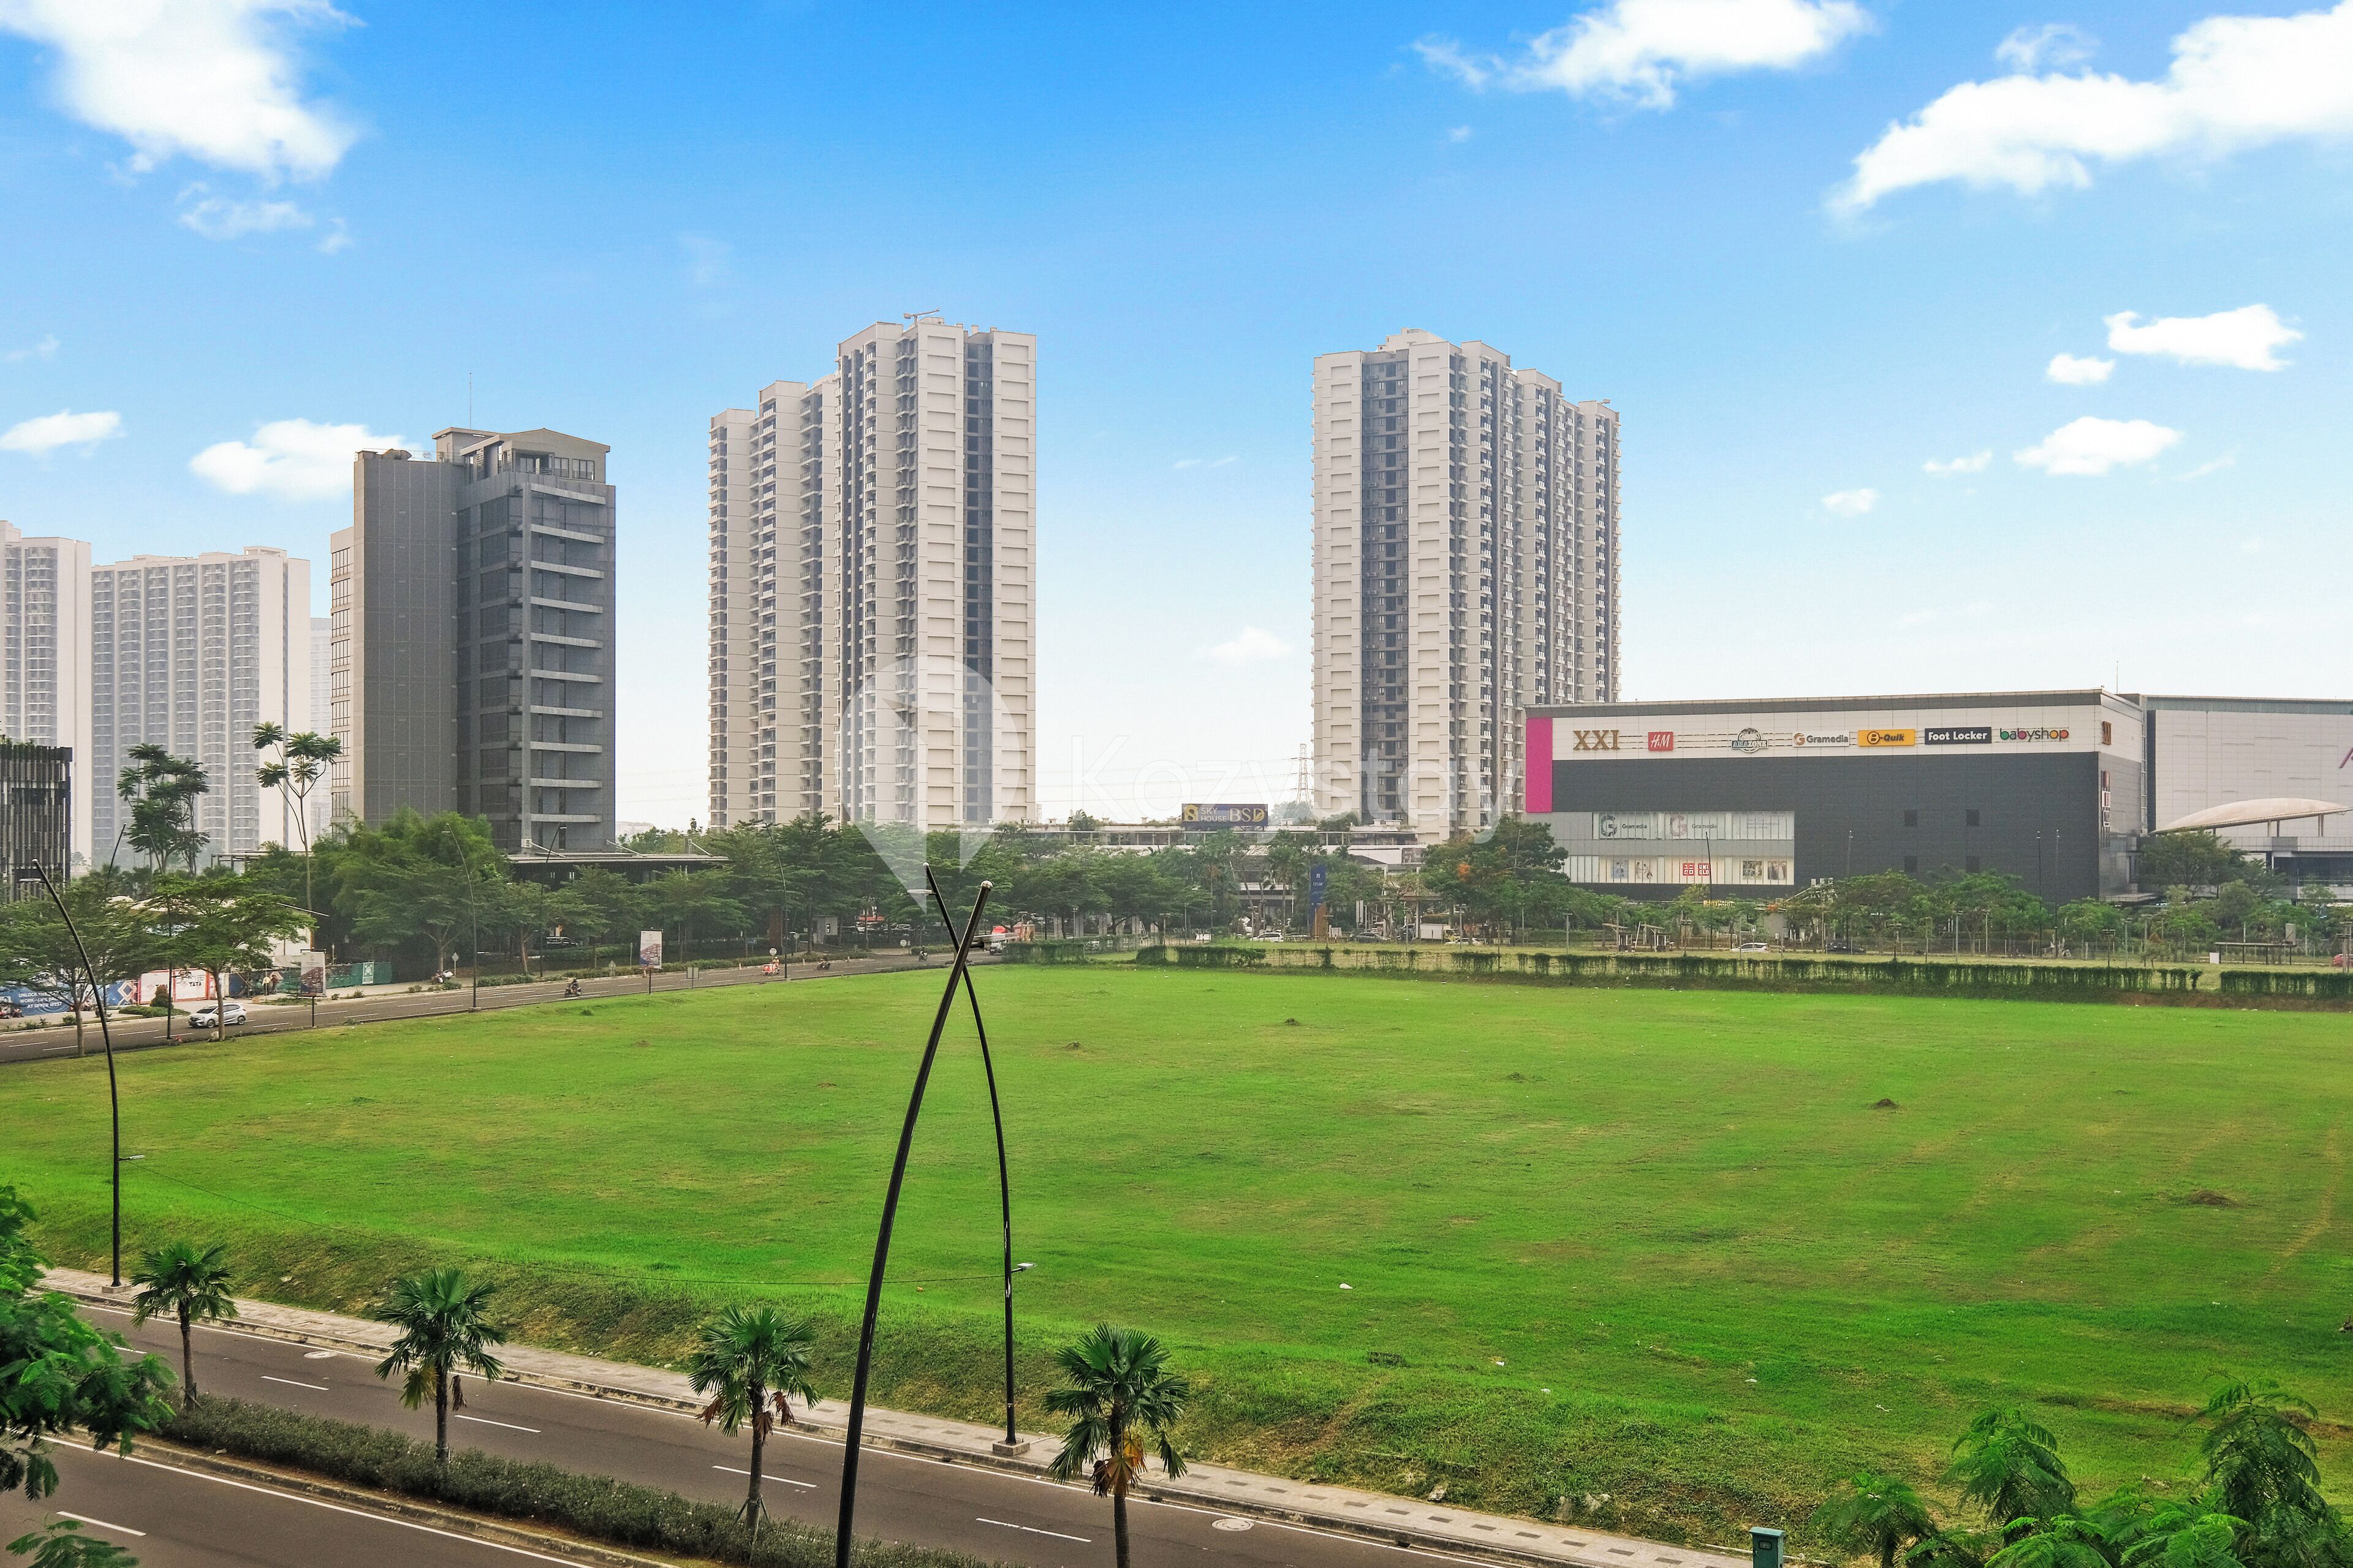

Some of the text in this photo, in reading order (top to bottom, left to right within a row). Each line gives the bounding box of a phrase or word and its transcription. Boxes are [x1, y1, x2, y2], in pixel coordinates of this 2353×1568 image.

[1573, 729, 1620, 750] XXI
[1650, 734, 1670, 748] H&M
[1928, 731, 1987, 741] Foot Locker
[1999, 727, 2069, 742] babyshop
[1230, 808, 1265, 822] BSD
